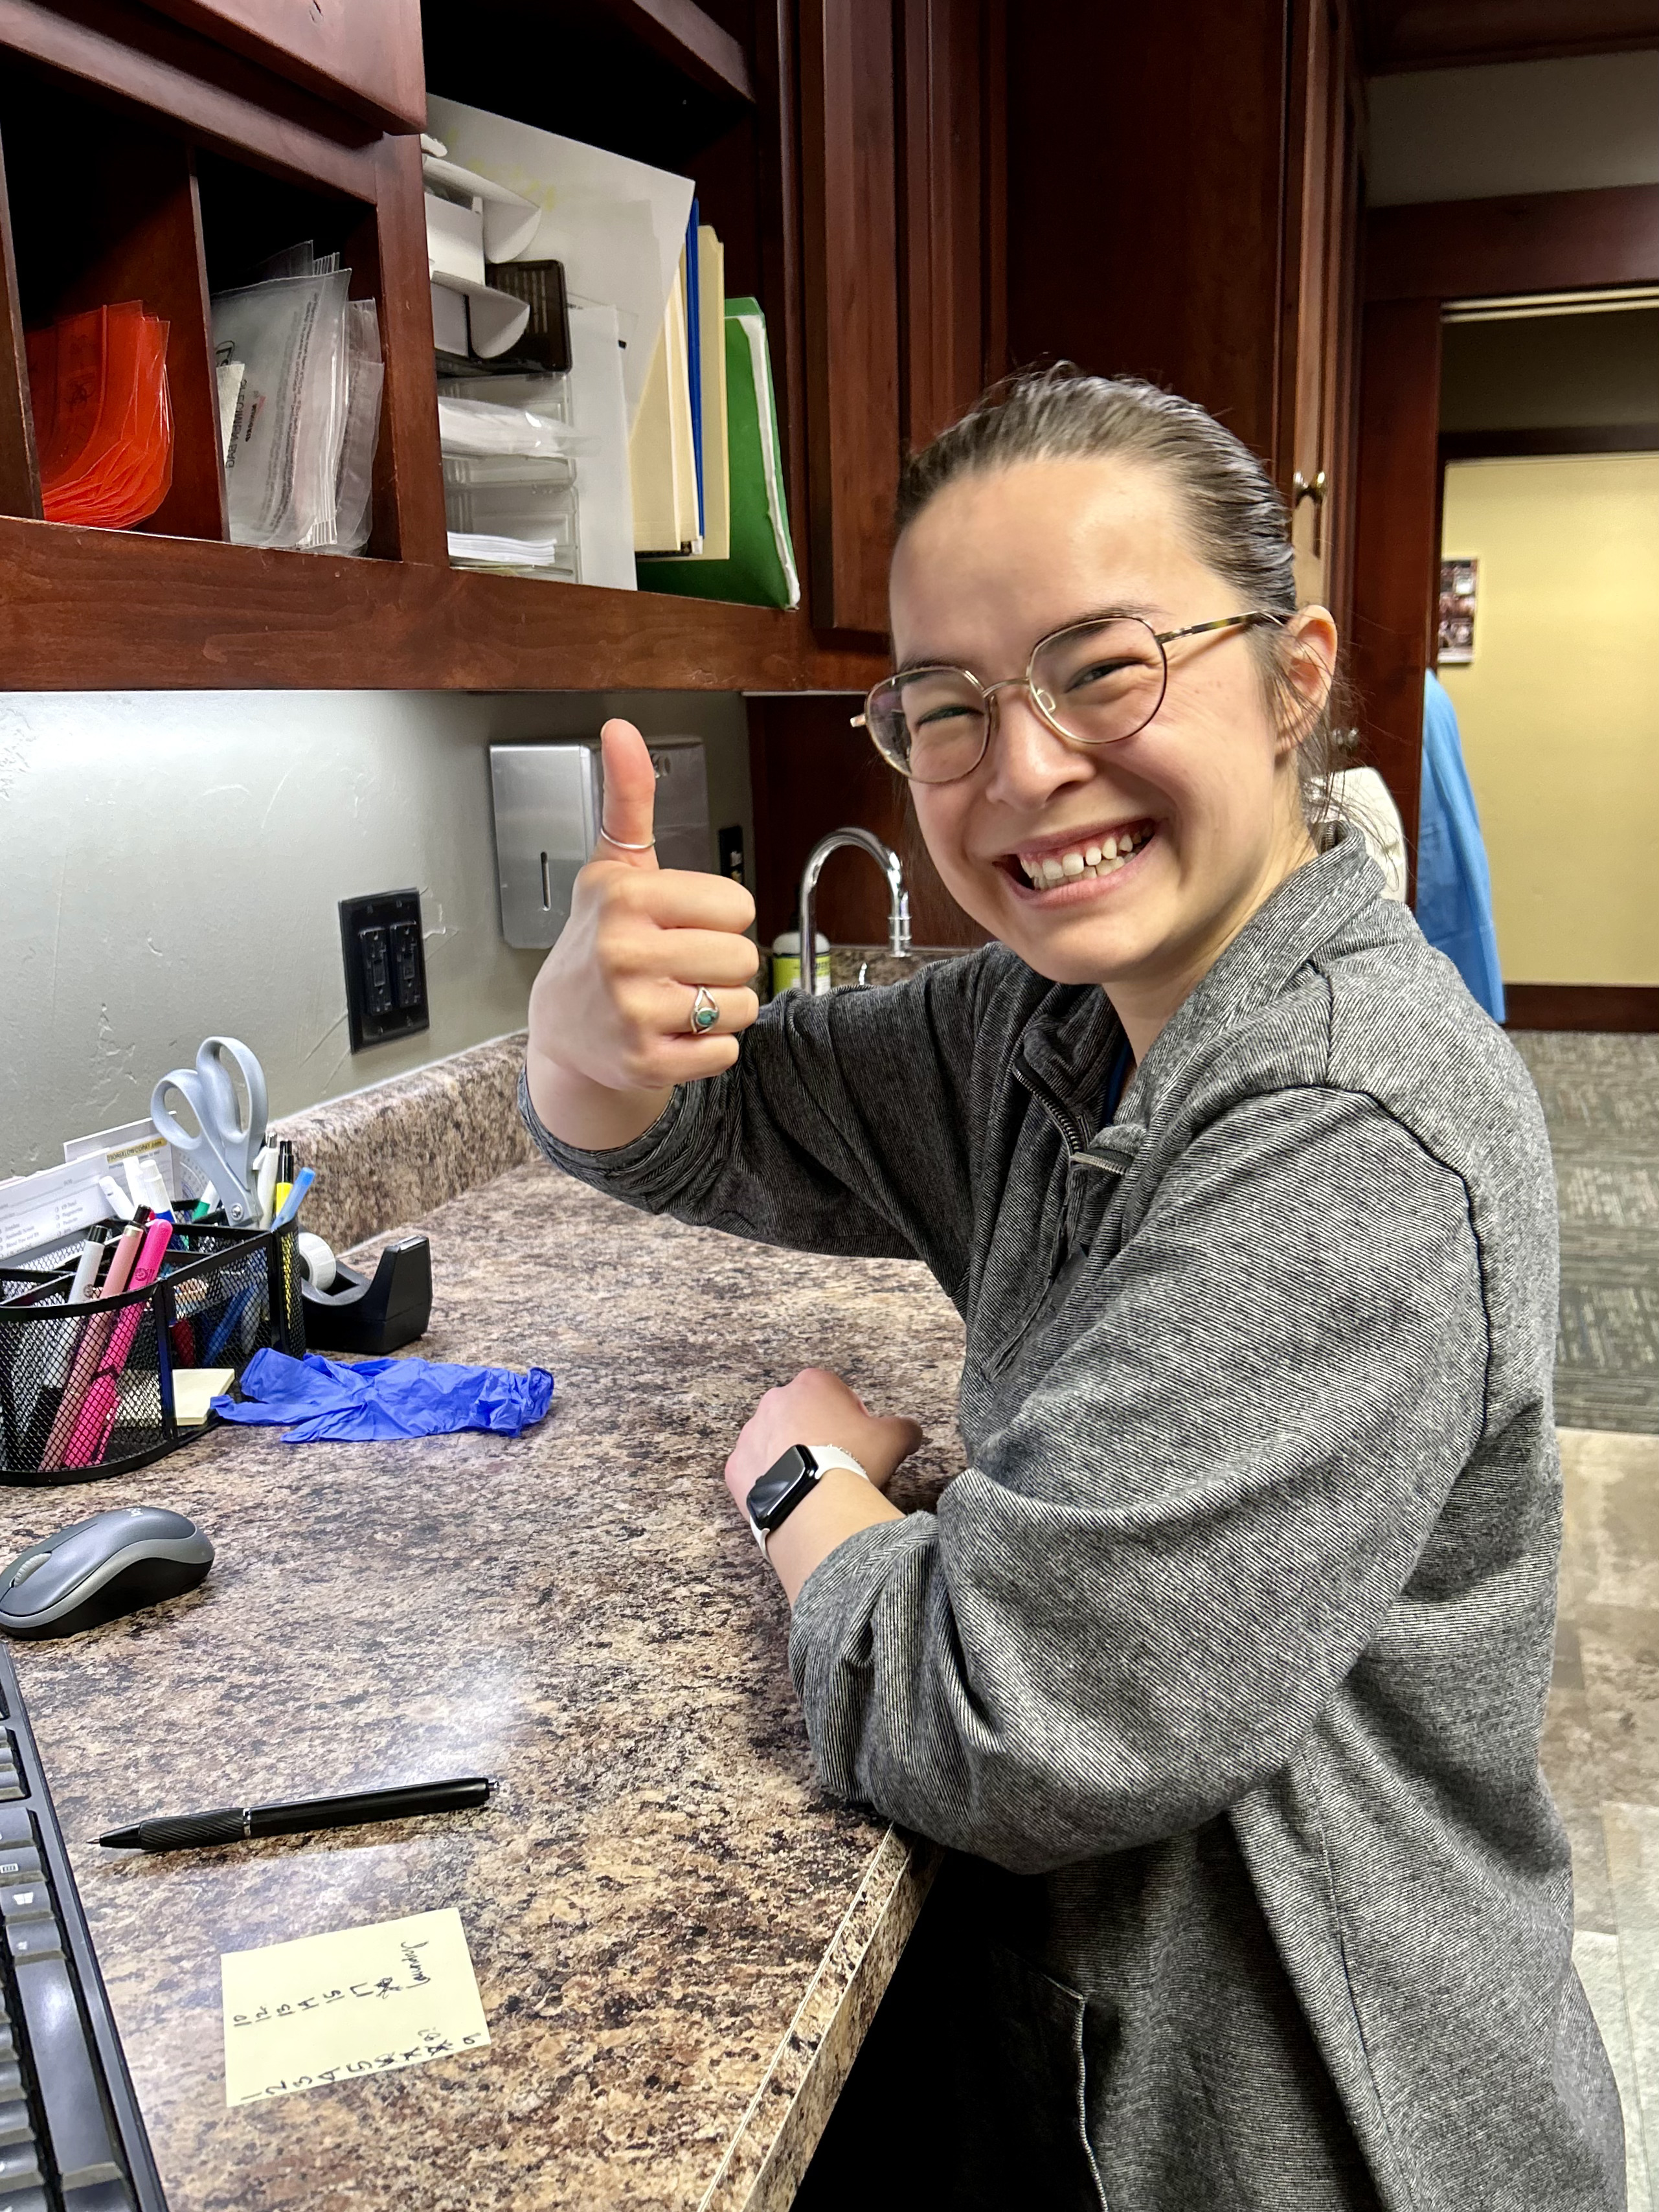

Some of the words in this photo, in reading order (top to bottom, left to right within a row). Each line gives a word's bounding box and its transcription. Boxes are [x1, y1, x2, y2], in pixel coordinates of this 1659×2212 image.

[322, 1990, 345, 2003] 15
[276, 2003, 296, 2016] 13
[298, 1997, 319, 2011] 14
[255, 2006, 272, 2022] 12
[233, 2015, 252, 2027] 10
[462, 2032, 481, 2044] 9
[346, 2060, 373, 2072] 5
[317, 2066, 341, 2081] 4
[265, 2079, 287, 2095] 2
[293, 2075, 313, 2088] 3
